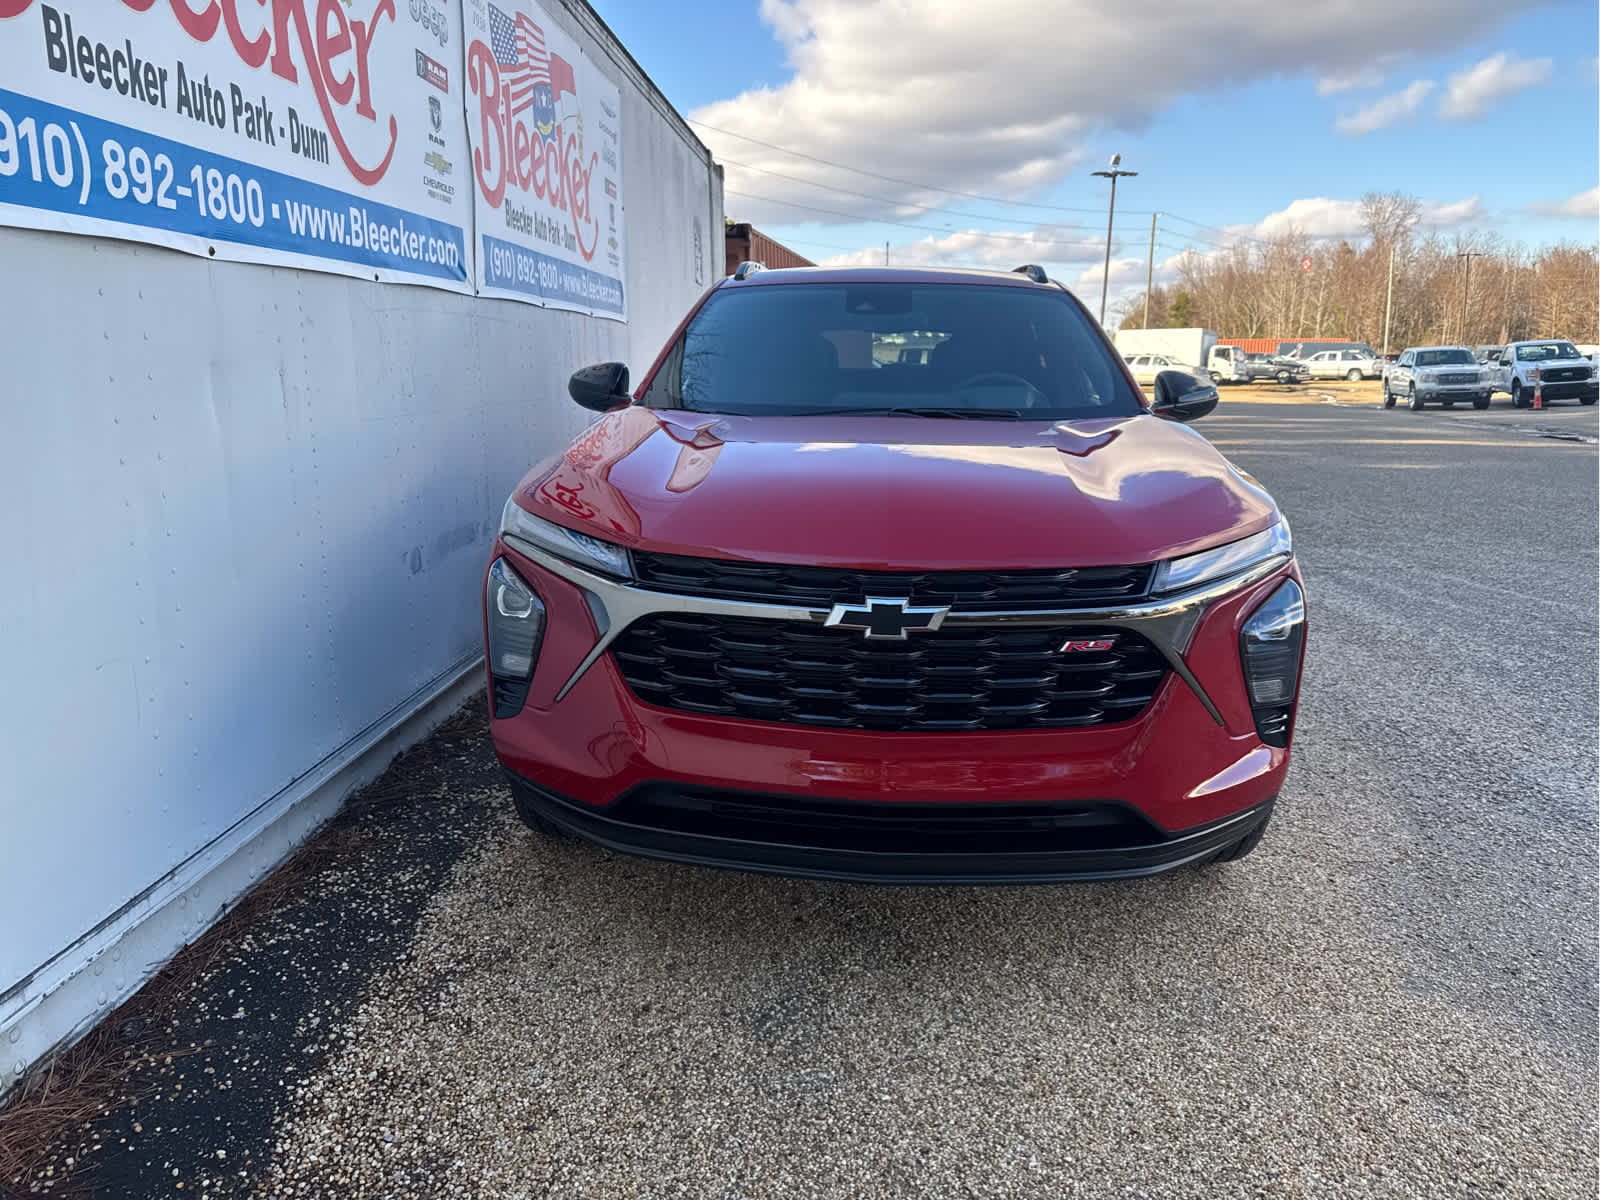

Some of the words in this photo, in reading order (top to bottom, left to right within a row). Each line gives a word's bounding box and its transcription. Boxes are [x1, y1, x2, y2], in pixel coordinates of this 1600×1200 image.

[41, 3, 168, 109] Bleecker
[177, 60, 226, 130] Auto
[230, 82, 276, 146] Park
[288, 106, 329, 164] Dunn
[0, 108, 91, 205] 910)
[102, 138, 264, 228] 892-1800
[285, 199, 459, 268] www.Bleecker.com
[467, 39, 599, 262] Bleecker
[489, 241, 516, 286] (910)
[517, 253, 558, 288] 892-1800
[505, 198, 533, 236] Bleecker
[534, 211, 548, 242] Auto
[1060, 639, 1115, 652] RS
